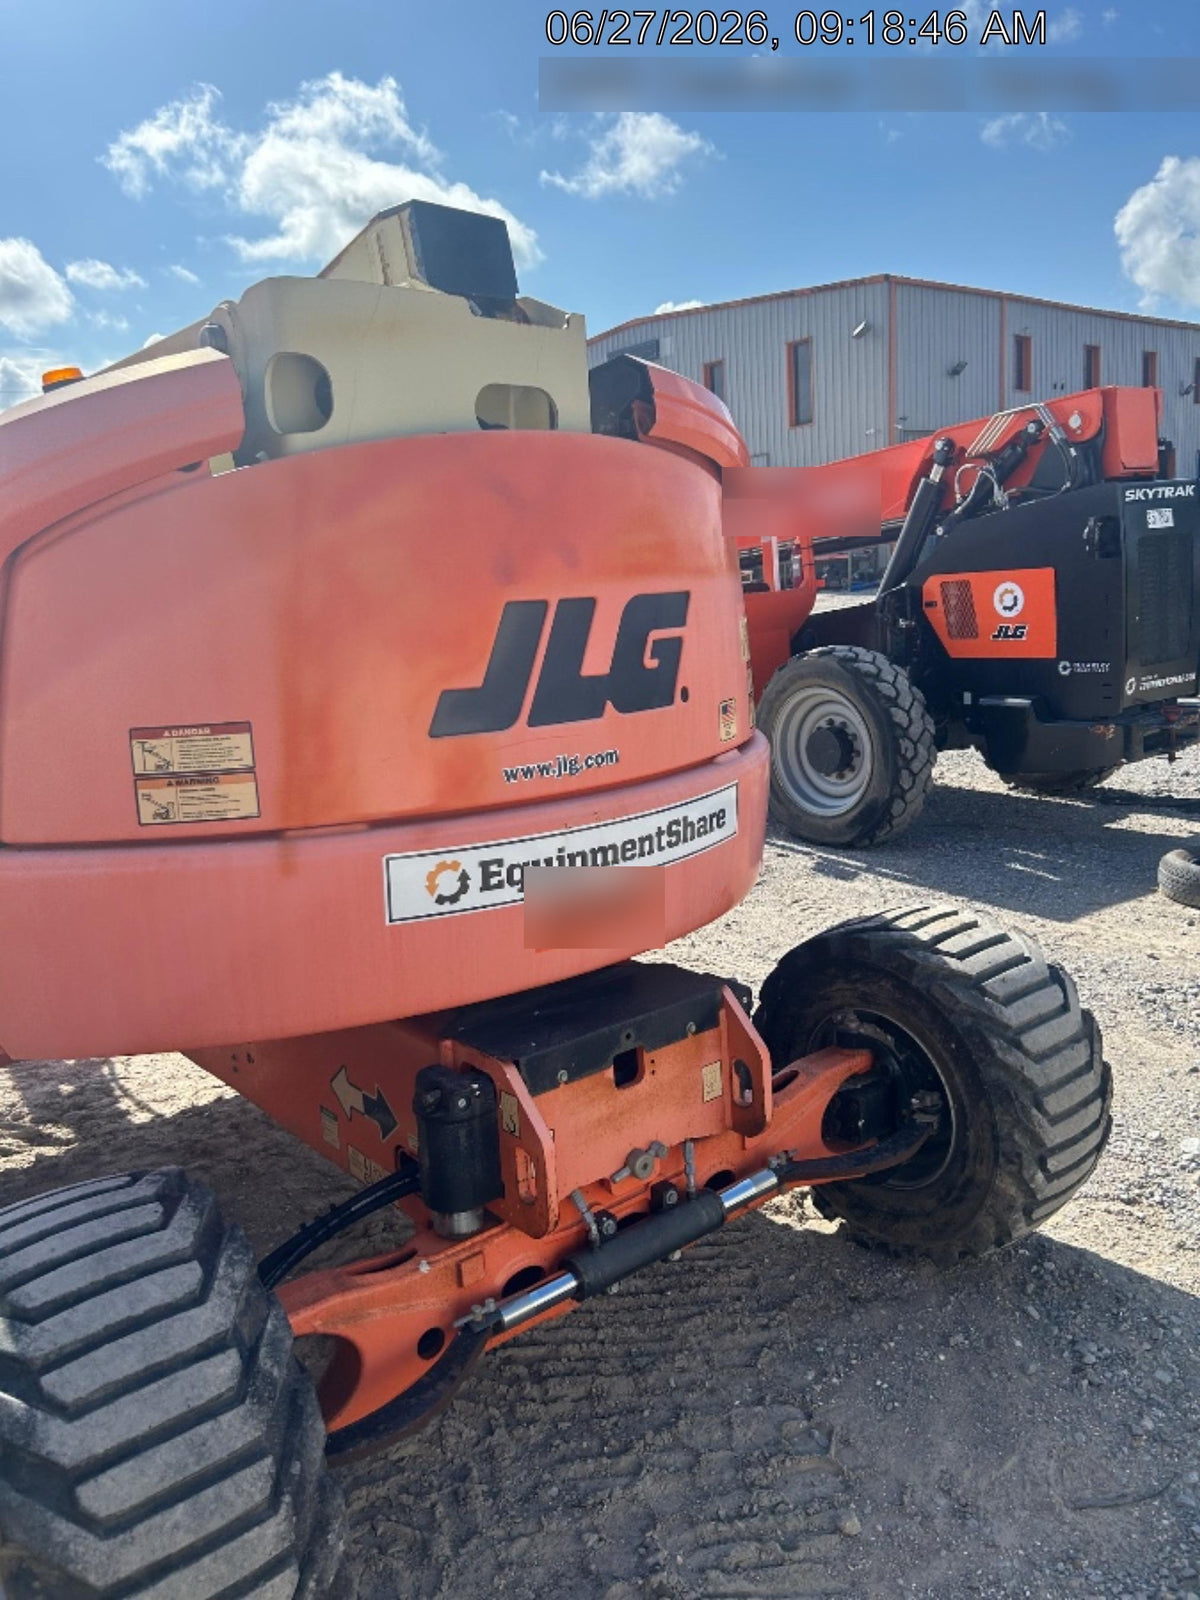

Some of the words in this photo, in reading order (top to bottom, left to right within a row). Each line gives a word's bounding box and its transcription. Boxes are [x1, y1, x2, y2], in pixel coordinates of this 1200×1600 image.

[1124, 485, 1196, 502] SKYTRAK
[991, 624, 1028, 640] JLG
[428, 591, 690, 738] JLG
[503, 748, 620, 783] www.jlg.com
